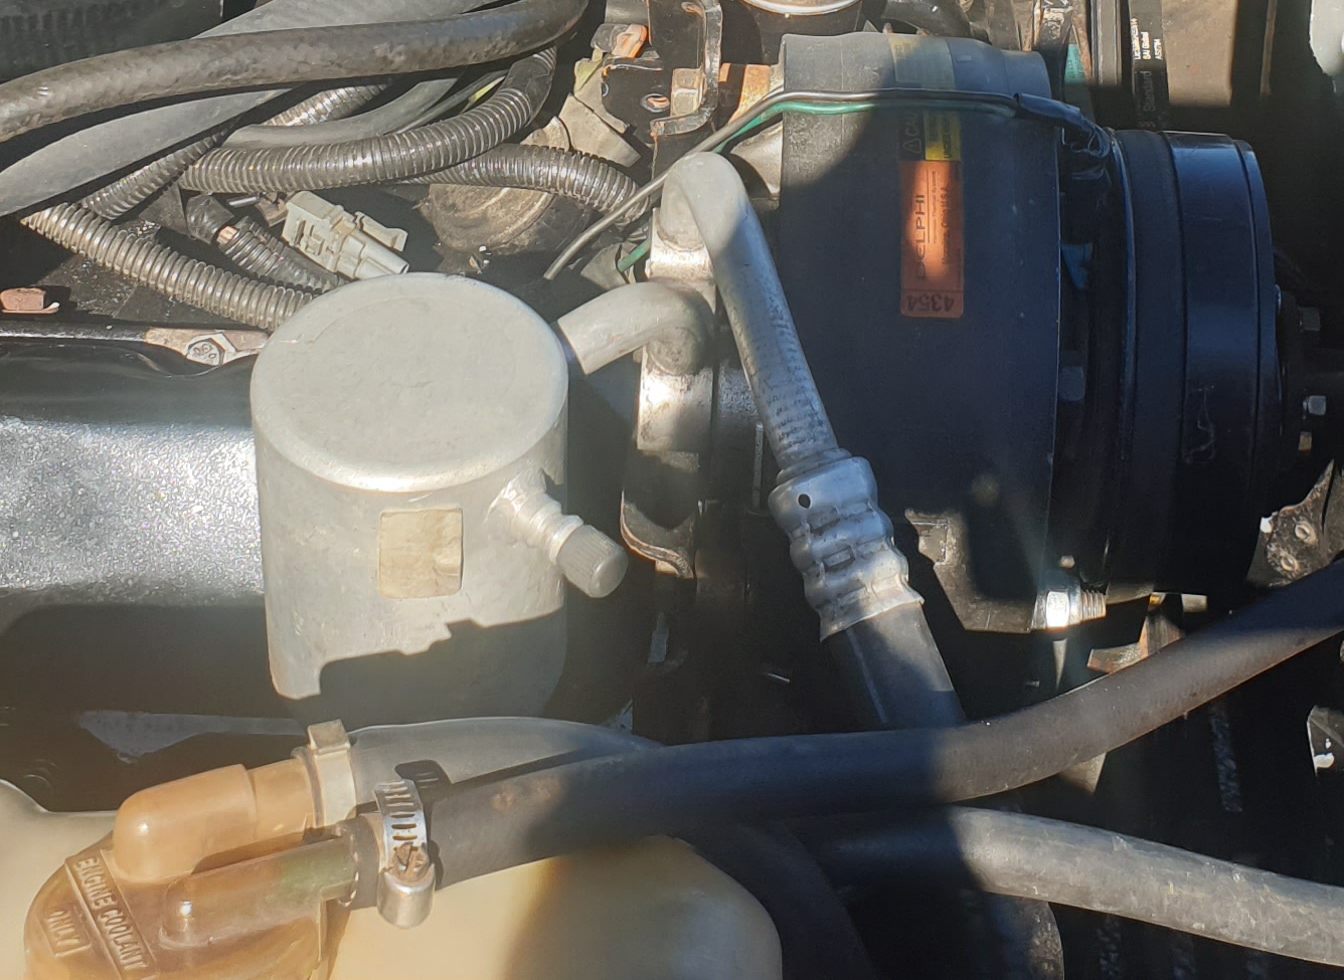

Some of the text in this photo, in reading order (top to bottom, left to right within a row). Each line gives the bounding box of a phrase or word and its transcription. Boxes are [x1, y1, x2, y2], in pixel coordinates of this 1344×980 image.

[915, 194, 926, 280] DELPHI
[907, 295, 955, 313] 4354
[44, 910, 80, 948] ONLY
[74, 858, 148, 972] ENGINE COOLANT
